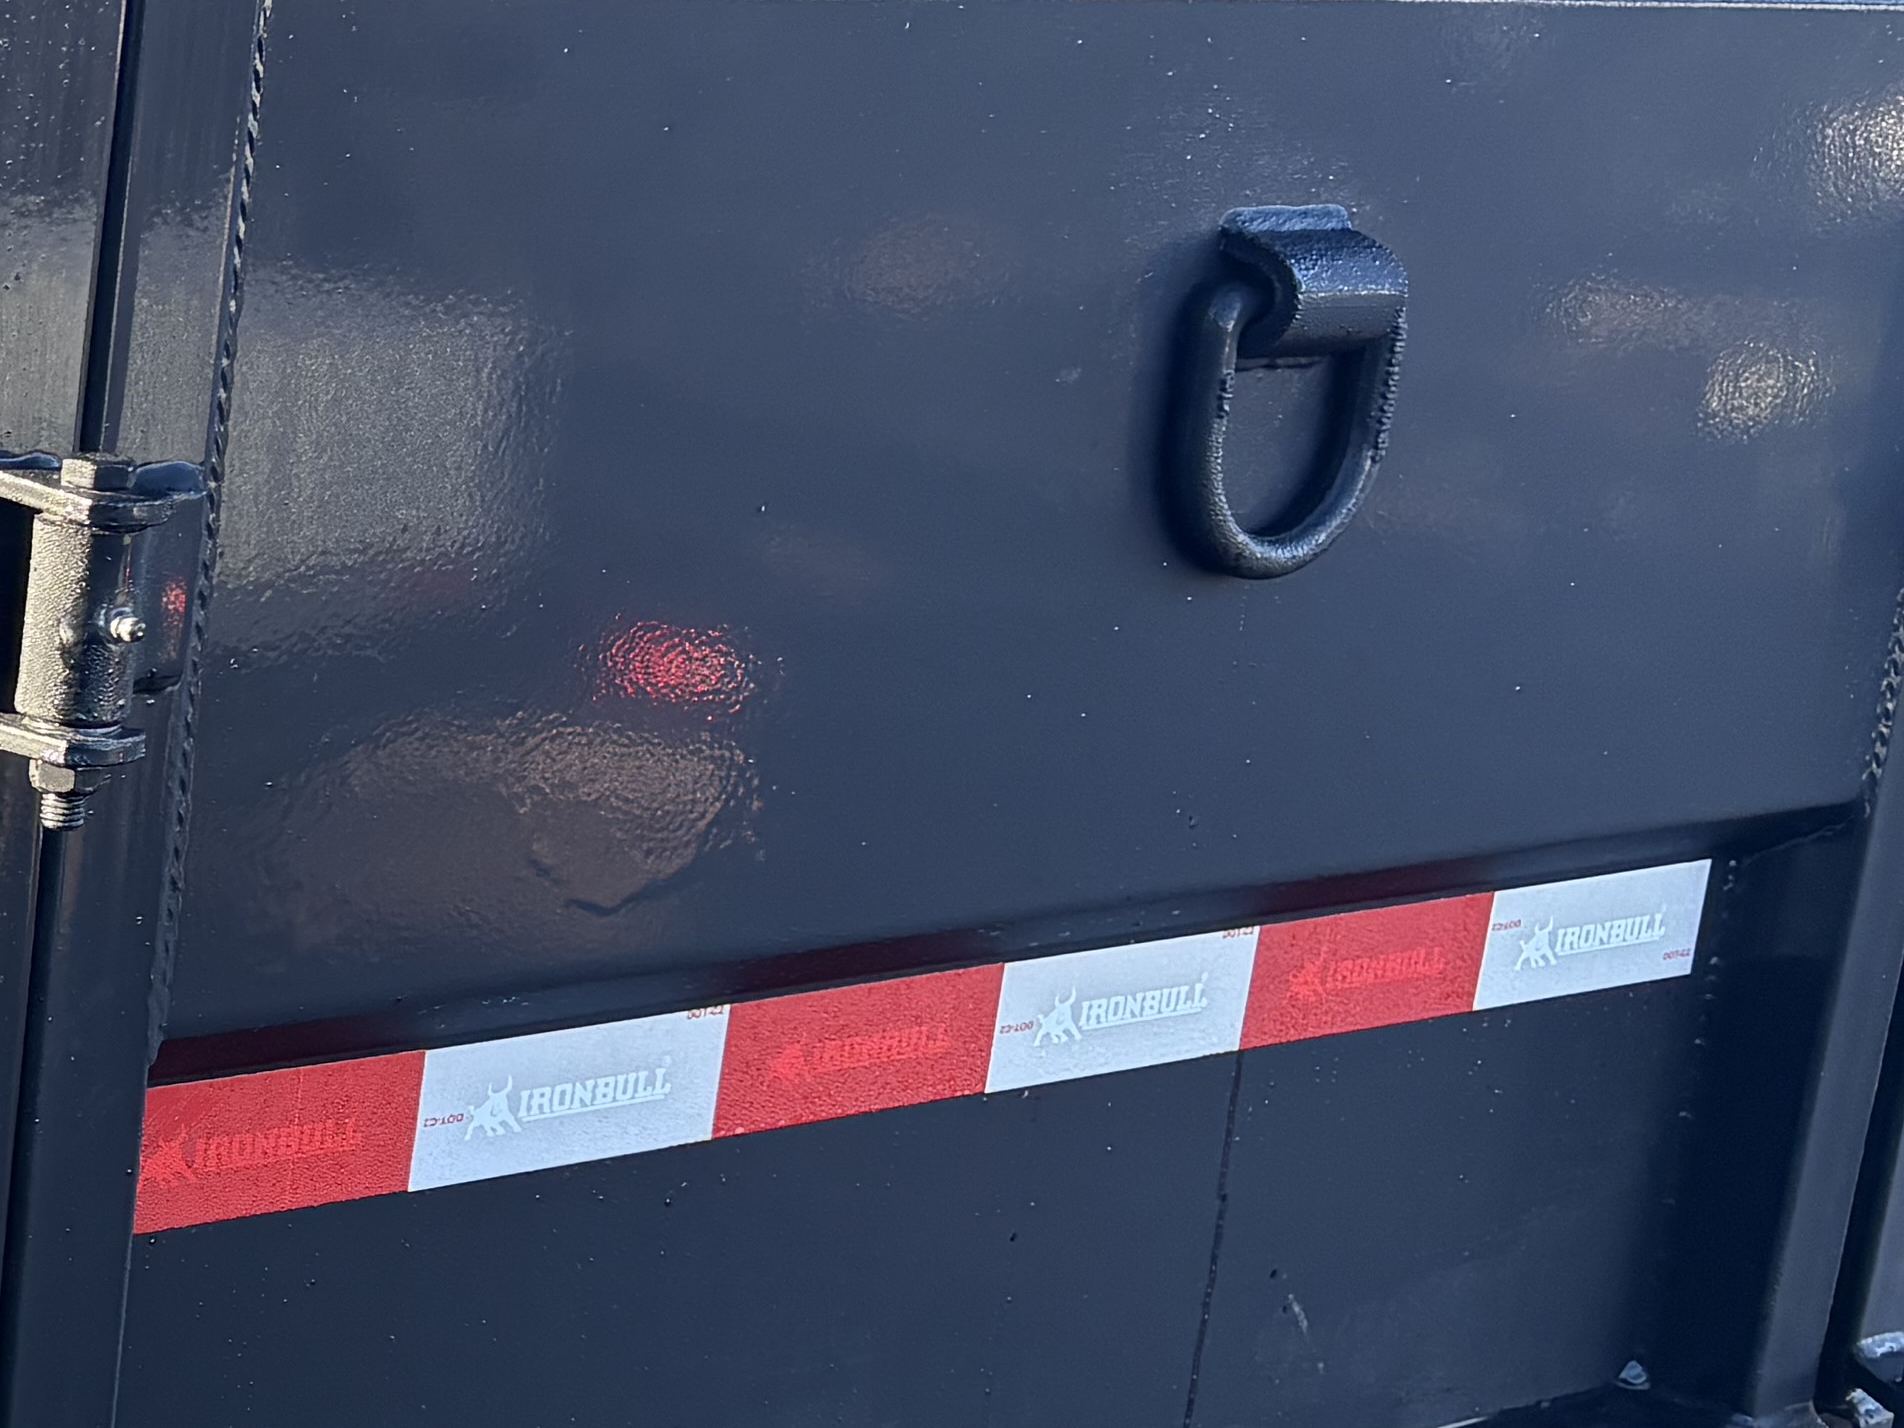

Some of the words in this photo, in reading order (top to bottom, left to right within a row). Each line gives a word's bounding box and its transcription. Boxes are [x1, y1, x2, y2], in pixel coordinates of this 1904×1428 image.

[1555, 913, 1666, 953] IRONBULL
[1078, 983, 1208, 1027] IRONBULL
[518, 1067, 671, 1118] IRONBULL
